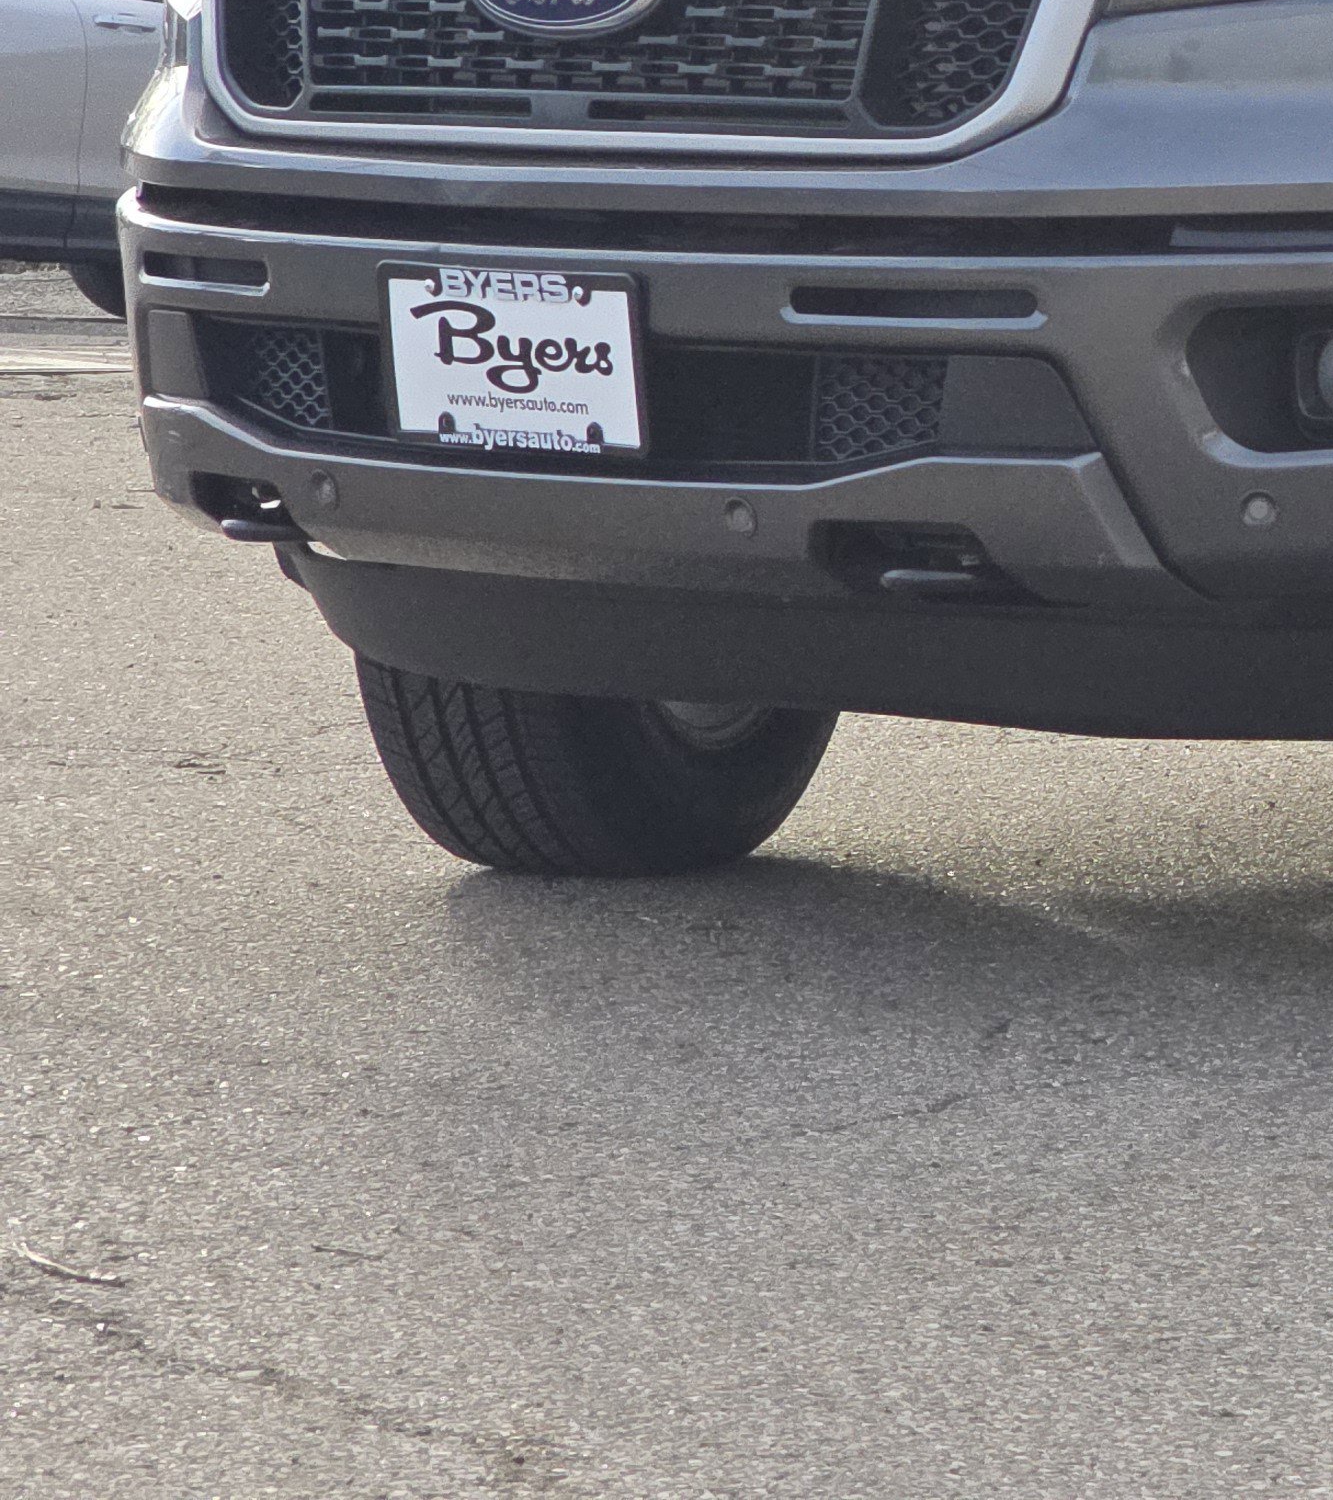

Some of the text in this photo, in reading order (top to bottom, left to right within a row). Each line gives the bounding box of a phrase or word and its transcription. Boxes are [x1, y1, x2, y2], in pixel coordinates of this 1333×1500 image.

[438, 268, 572, 303] BYERS
[409, 300, 614, 394] Byers
[446, 391, 590, 416] www.byersauto.com
[438, 424, 601, 454] www.byersauto.com
